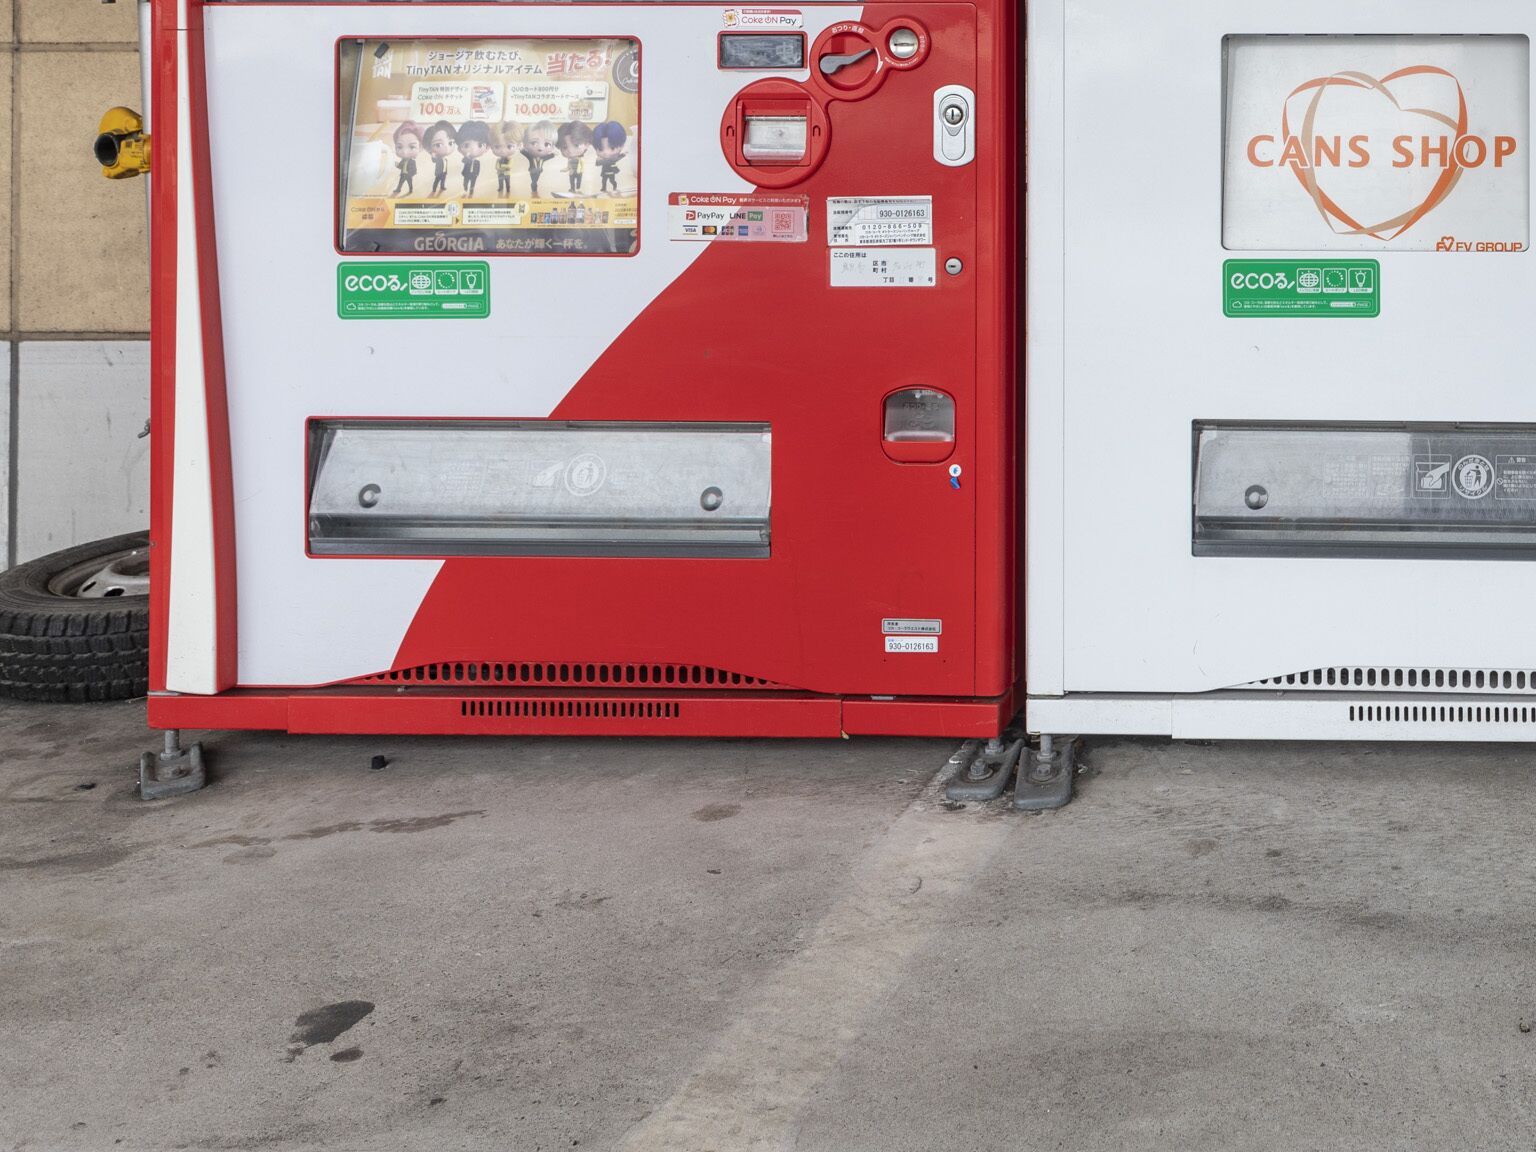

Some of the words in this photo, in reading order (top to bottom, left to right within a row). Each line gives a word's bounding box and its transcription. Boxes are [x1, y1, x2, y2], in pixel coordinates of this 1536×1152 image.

[742, 16, 763, 25] Coke
[780, 17, 796, 26] Pay
[1246, 134, 1371, 169] CANS
[1391, 134, 1517, 169] SHOP
[722, 196, 736, 204] Pay
[698, 212, 724, 220] PayPay
[730, 212, 746, 220] LINE
[1456, 242, 1472, 252] FV
[1476, 241, 1523, 252] GROUP
